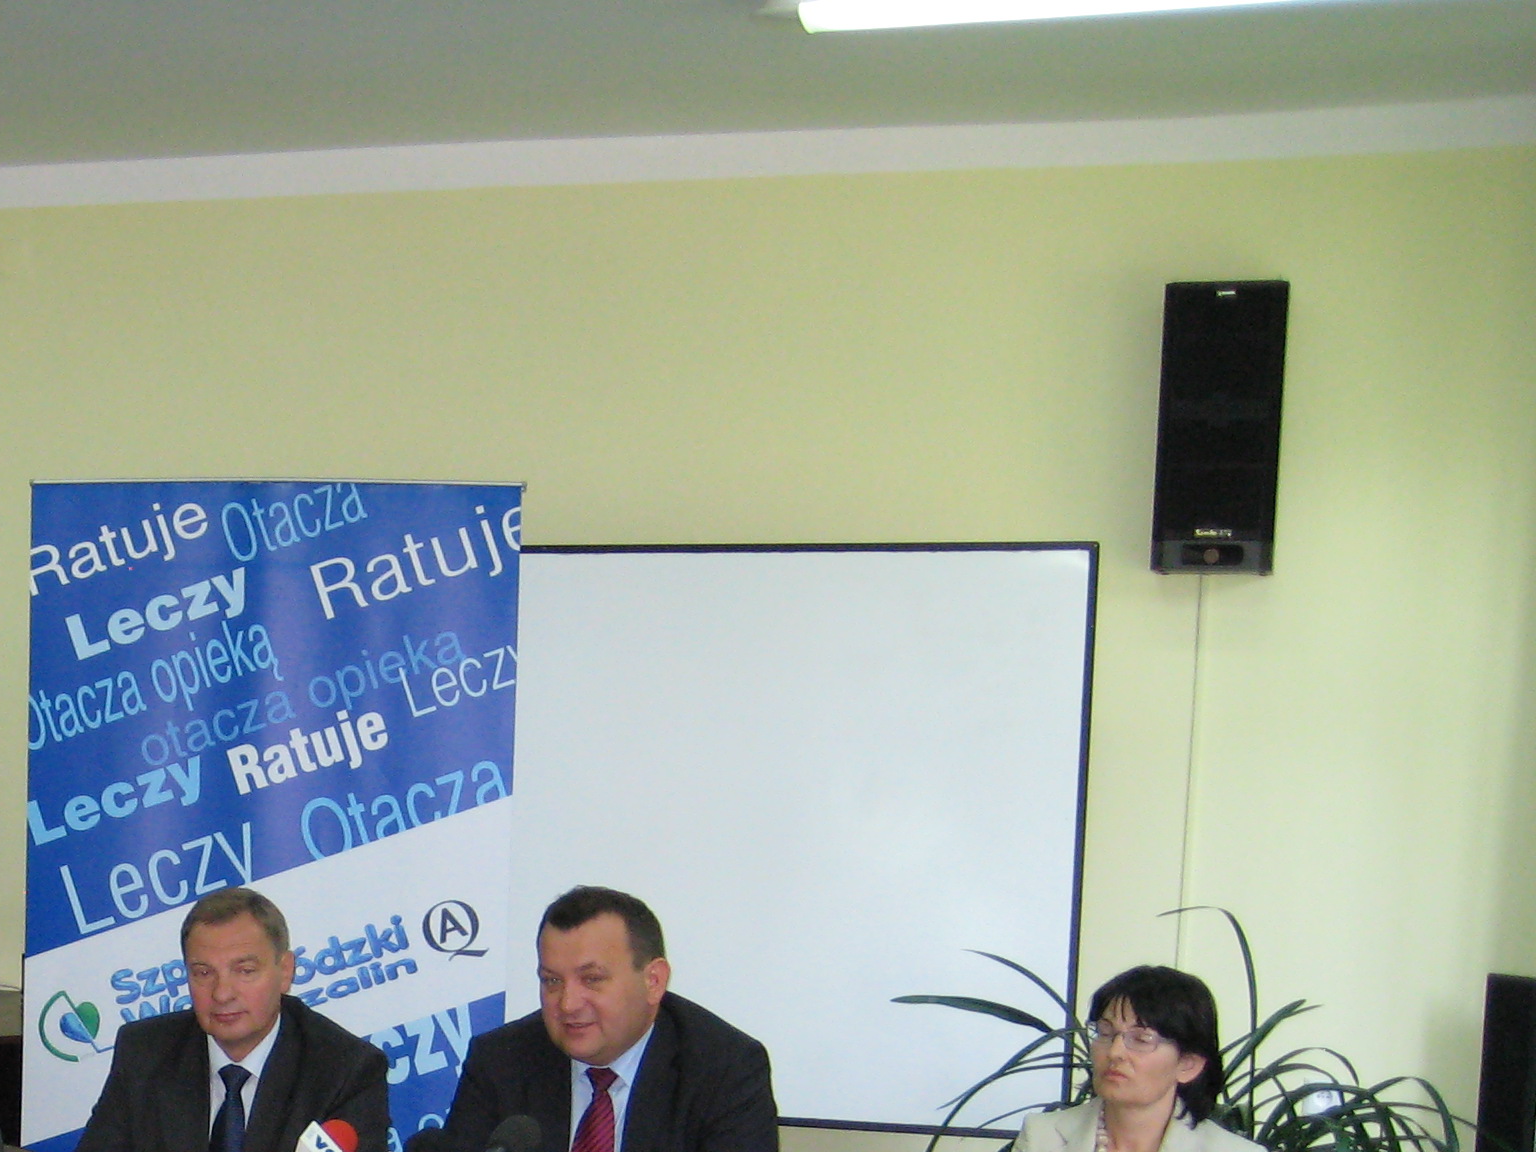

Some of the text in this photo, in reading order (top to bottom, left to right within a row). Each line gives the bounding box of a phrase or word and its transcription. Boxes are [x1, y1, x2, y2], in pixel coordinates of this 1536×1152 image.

[29, 502, 209, 597] Ratuje
[221, 482, 368, 562] Otacza
[65, 566, 246, 661] Leczy
[150, 620, 284, 712] opieką
[398, 644, 518, 718] Lecz
[140, 690, 297, 766] otacza
[226, 709, 389, 796] Ratuje
[27, 754, 201, 846] Leczy
[300, 760, 508, 861] Otacza
[59, 821, 252, 935] Leczy
